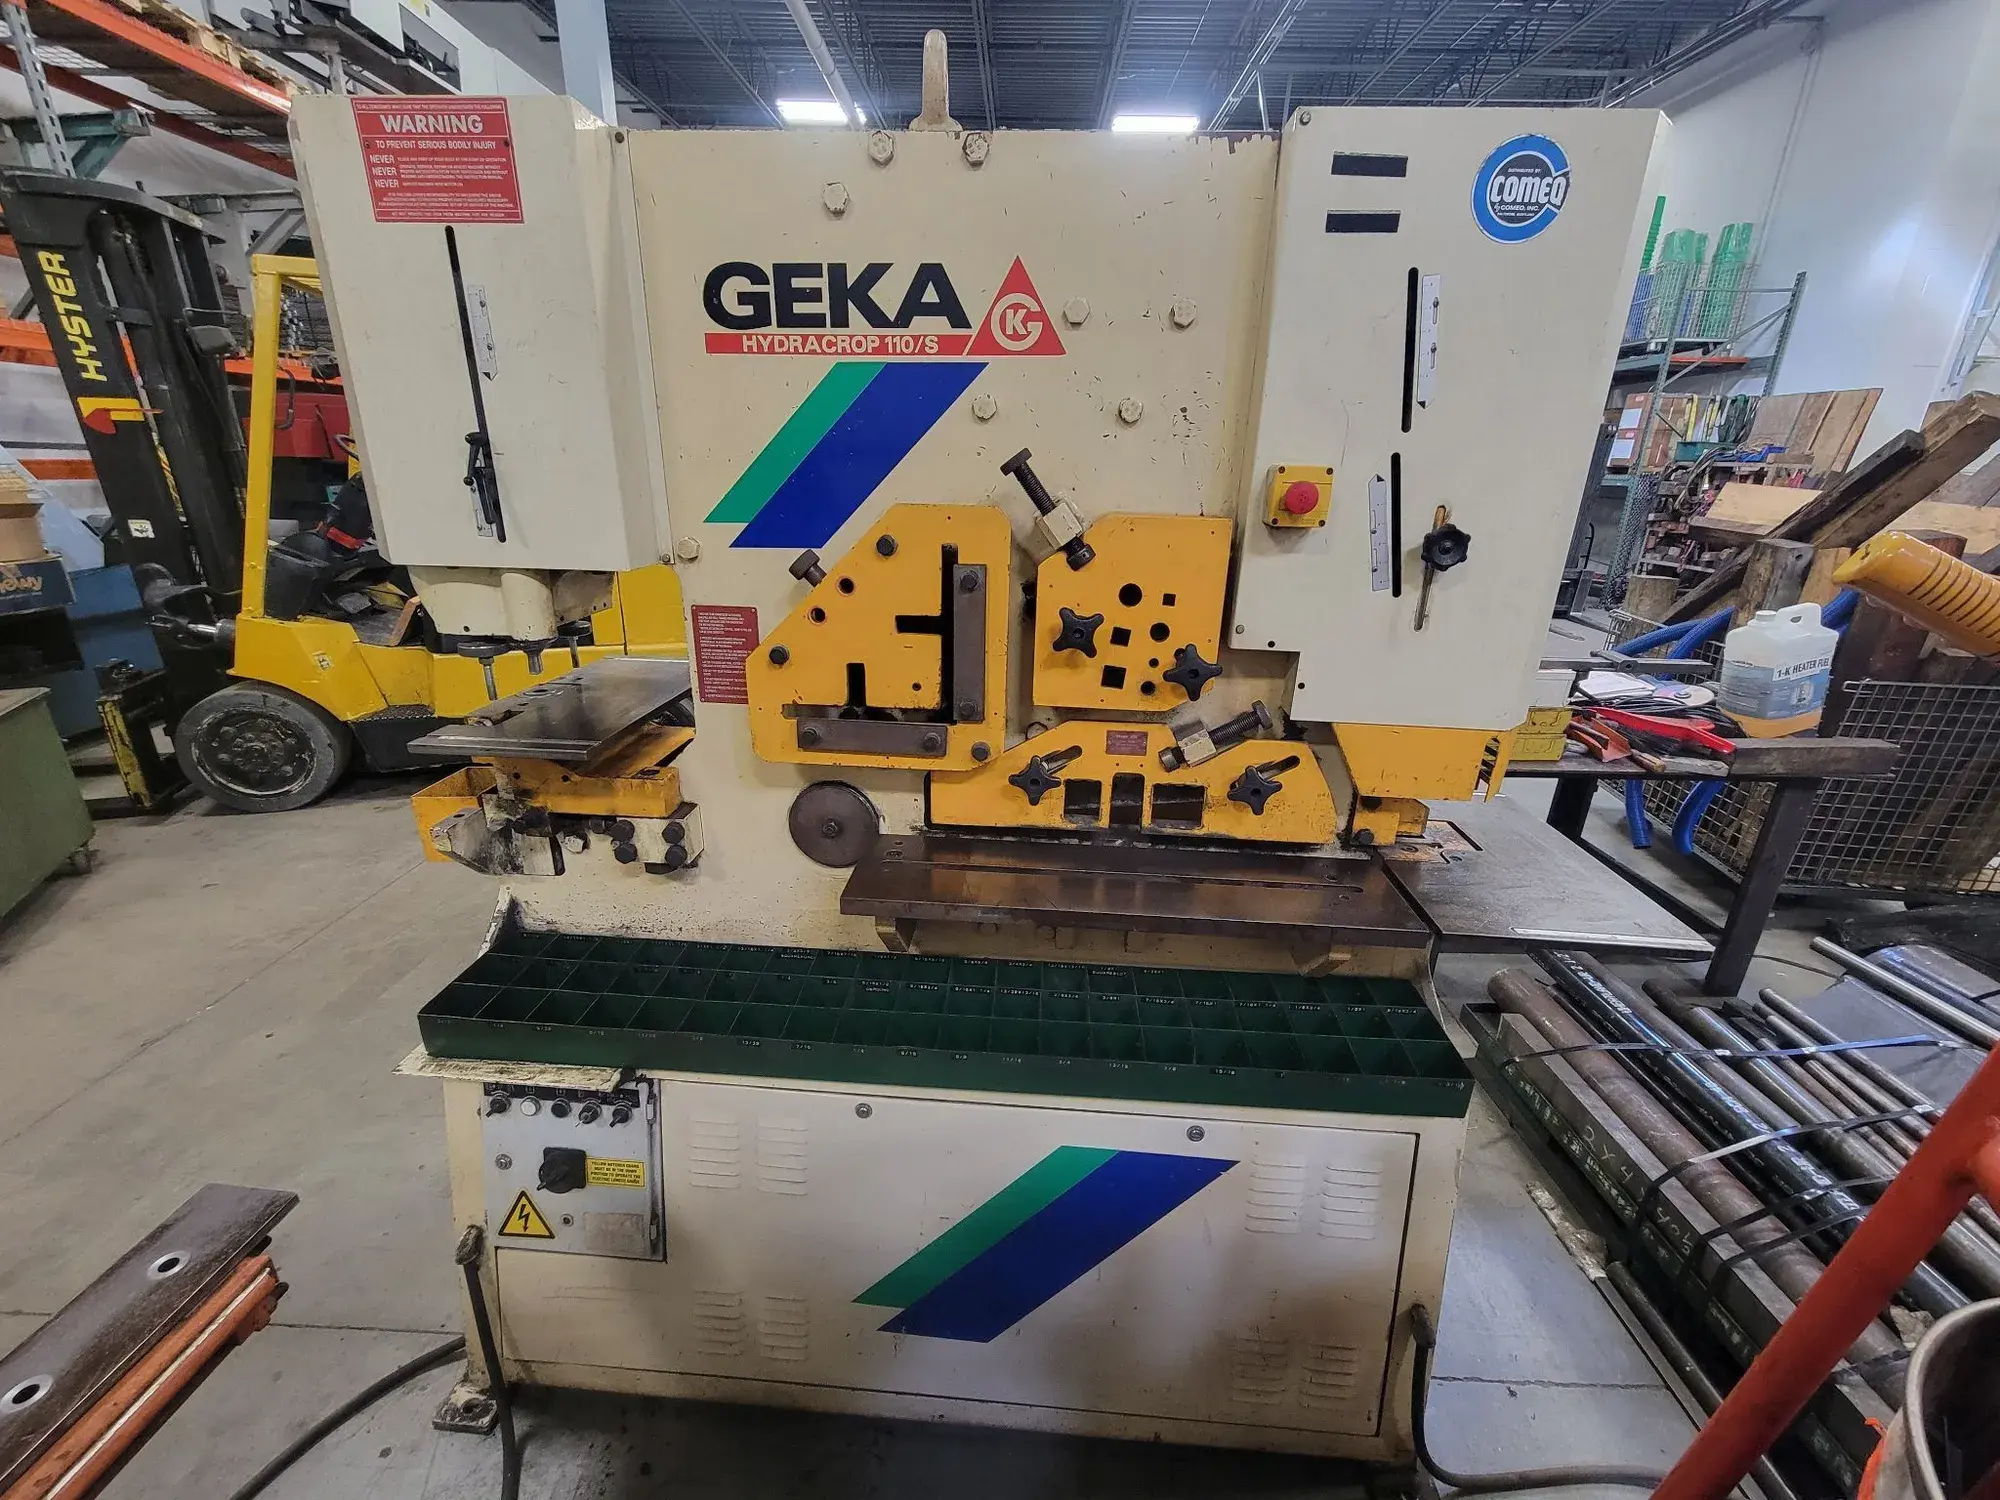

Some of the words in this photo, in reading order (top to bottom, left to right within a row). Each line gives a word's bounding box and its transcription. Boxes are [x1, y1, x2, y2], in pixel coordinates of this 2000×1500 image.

[380, 114, 484, 134] WARNING
[375, 140, 386, 149] TO
[387, 140, 416, 149] PREVENT
[418, 140, 447, 149] SERIOUS
[448, 140, 471, 149] BODILY
[473, 140, 496, 149] INJURY
[369, 154, 395, 164] NEVER
[372, 166, 397, 176] NEVER
[374, 179, 400, 188] NEVER
[1490, 175, 1567, 206] COMEQ
[703, 262, 972, 330] GEKA
[37, 250, 107, 382] HYSTER
[741, 335, 880, 353] HYDRACROP
[884, 335, 939, 354] 110/S
[1792, 659, 1817, 674] HEATER
